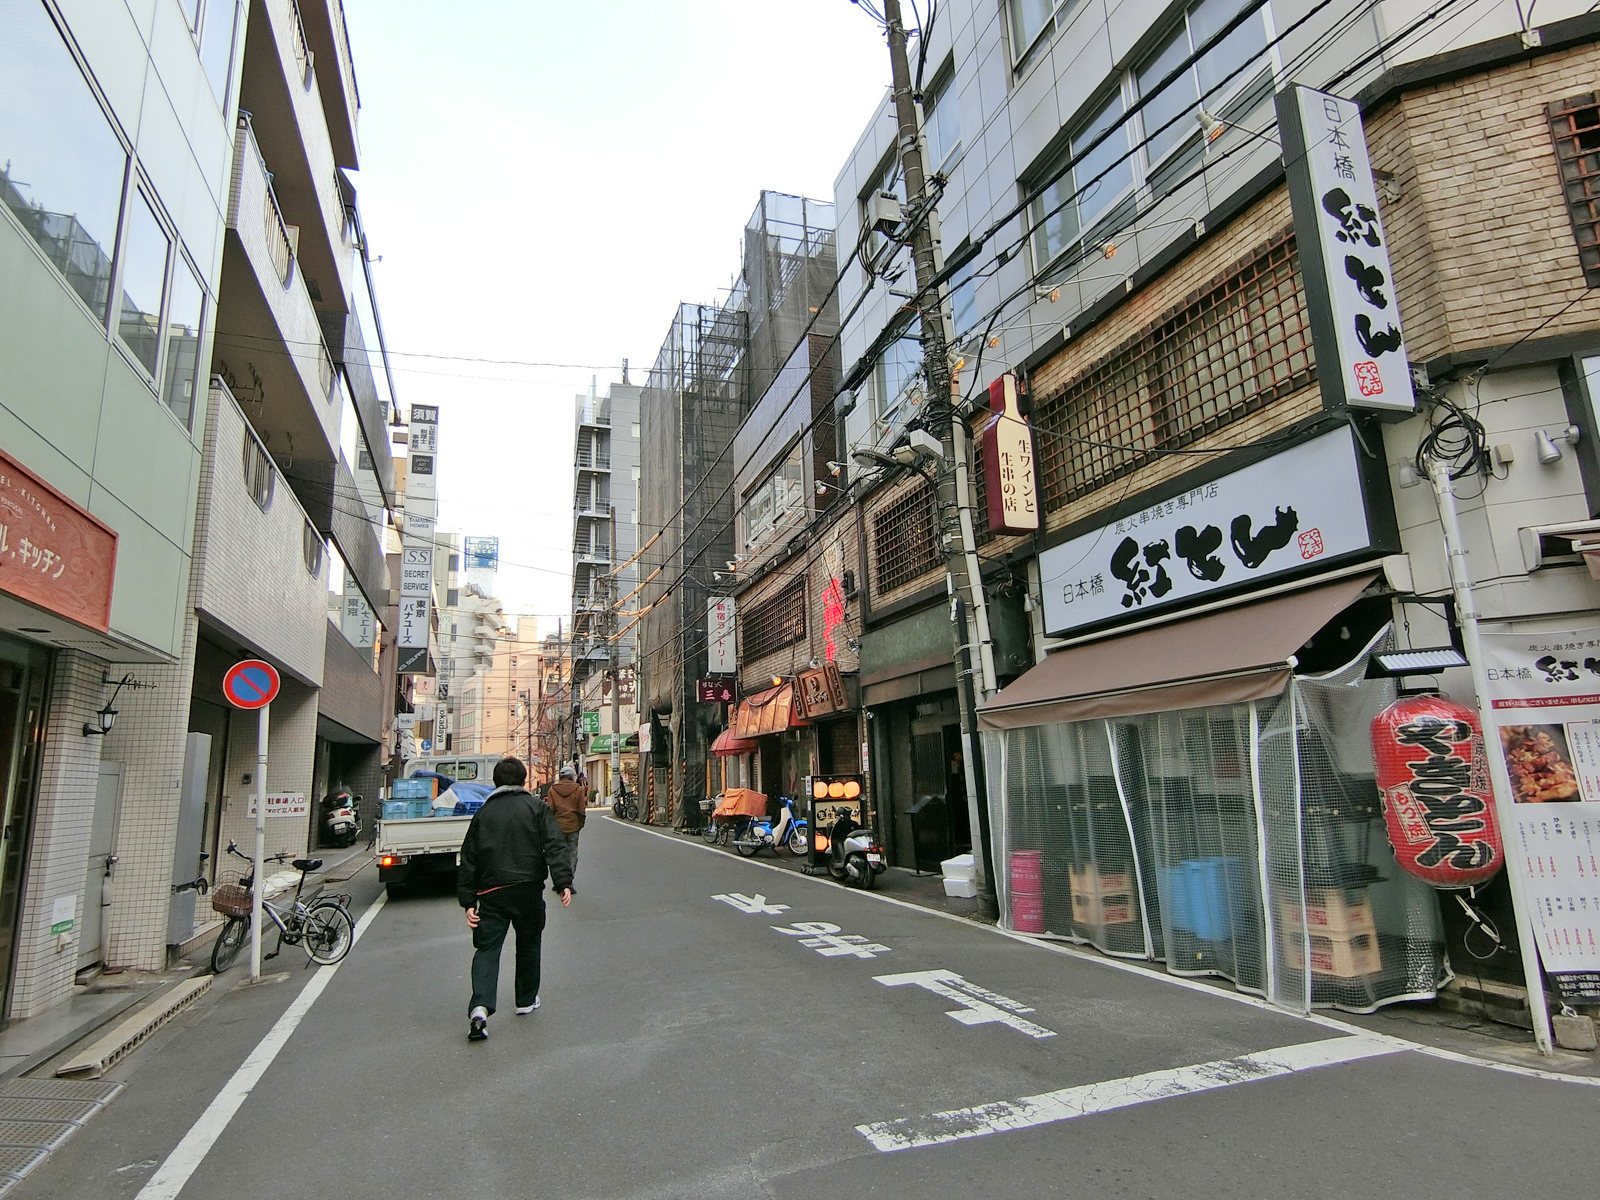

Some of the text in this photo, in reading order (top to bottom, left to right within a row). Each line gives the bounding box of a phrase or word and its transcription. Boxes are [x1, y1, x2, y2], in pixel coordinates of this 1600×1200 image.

[1322, 98, 1356, 183] 日本橋
[1001, 452, 1017, 512] 生串の店
[1018, 439, 1035, 513] 生ワインと
[1115, 482, 1219, 535] 炭火串焼き専門店
[407, 550, 428, 563] SS
[404, 570, 429, 578] SECRET
[404, 582, 429, 590] SERVICE
[1063, 573, 1105, 605] 日本橋
[416, 600, 426, 617] 東京
[716, 603, 726, 666] 新宿ランドリー
[1487, 666, 1532, 681] 日本橋
[437, 709, 446, 743] okadaya
[591, 713, 599, 728] くつ
[1395, 716, 1495, 869] やきとん
[1395, 791, 1427, 838] もつ焼
